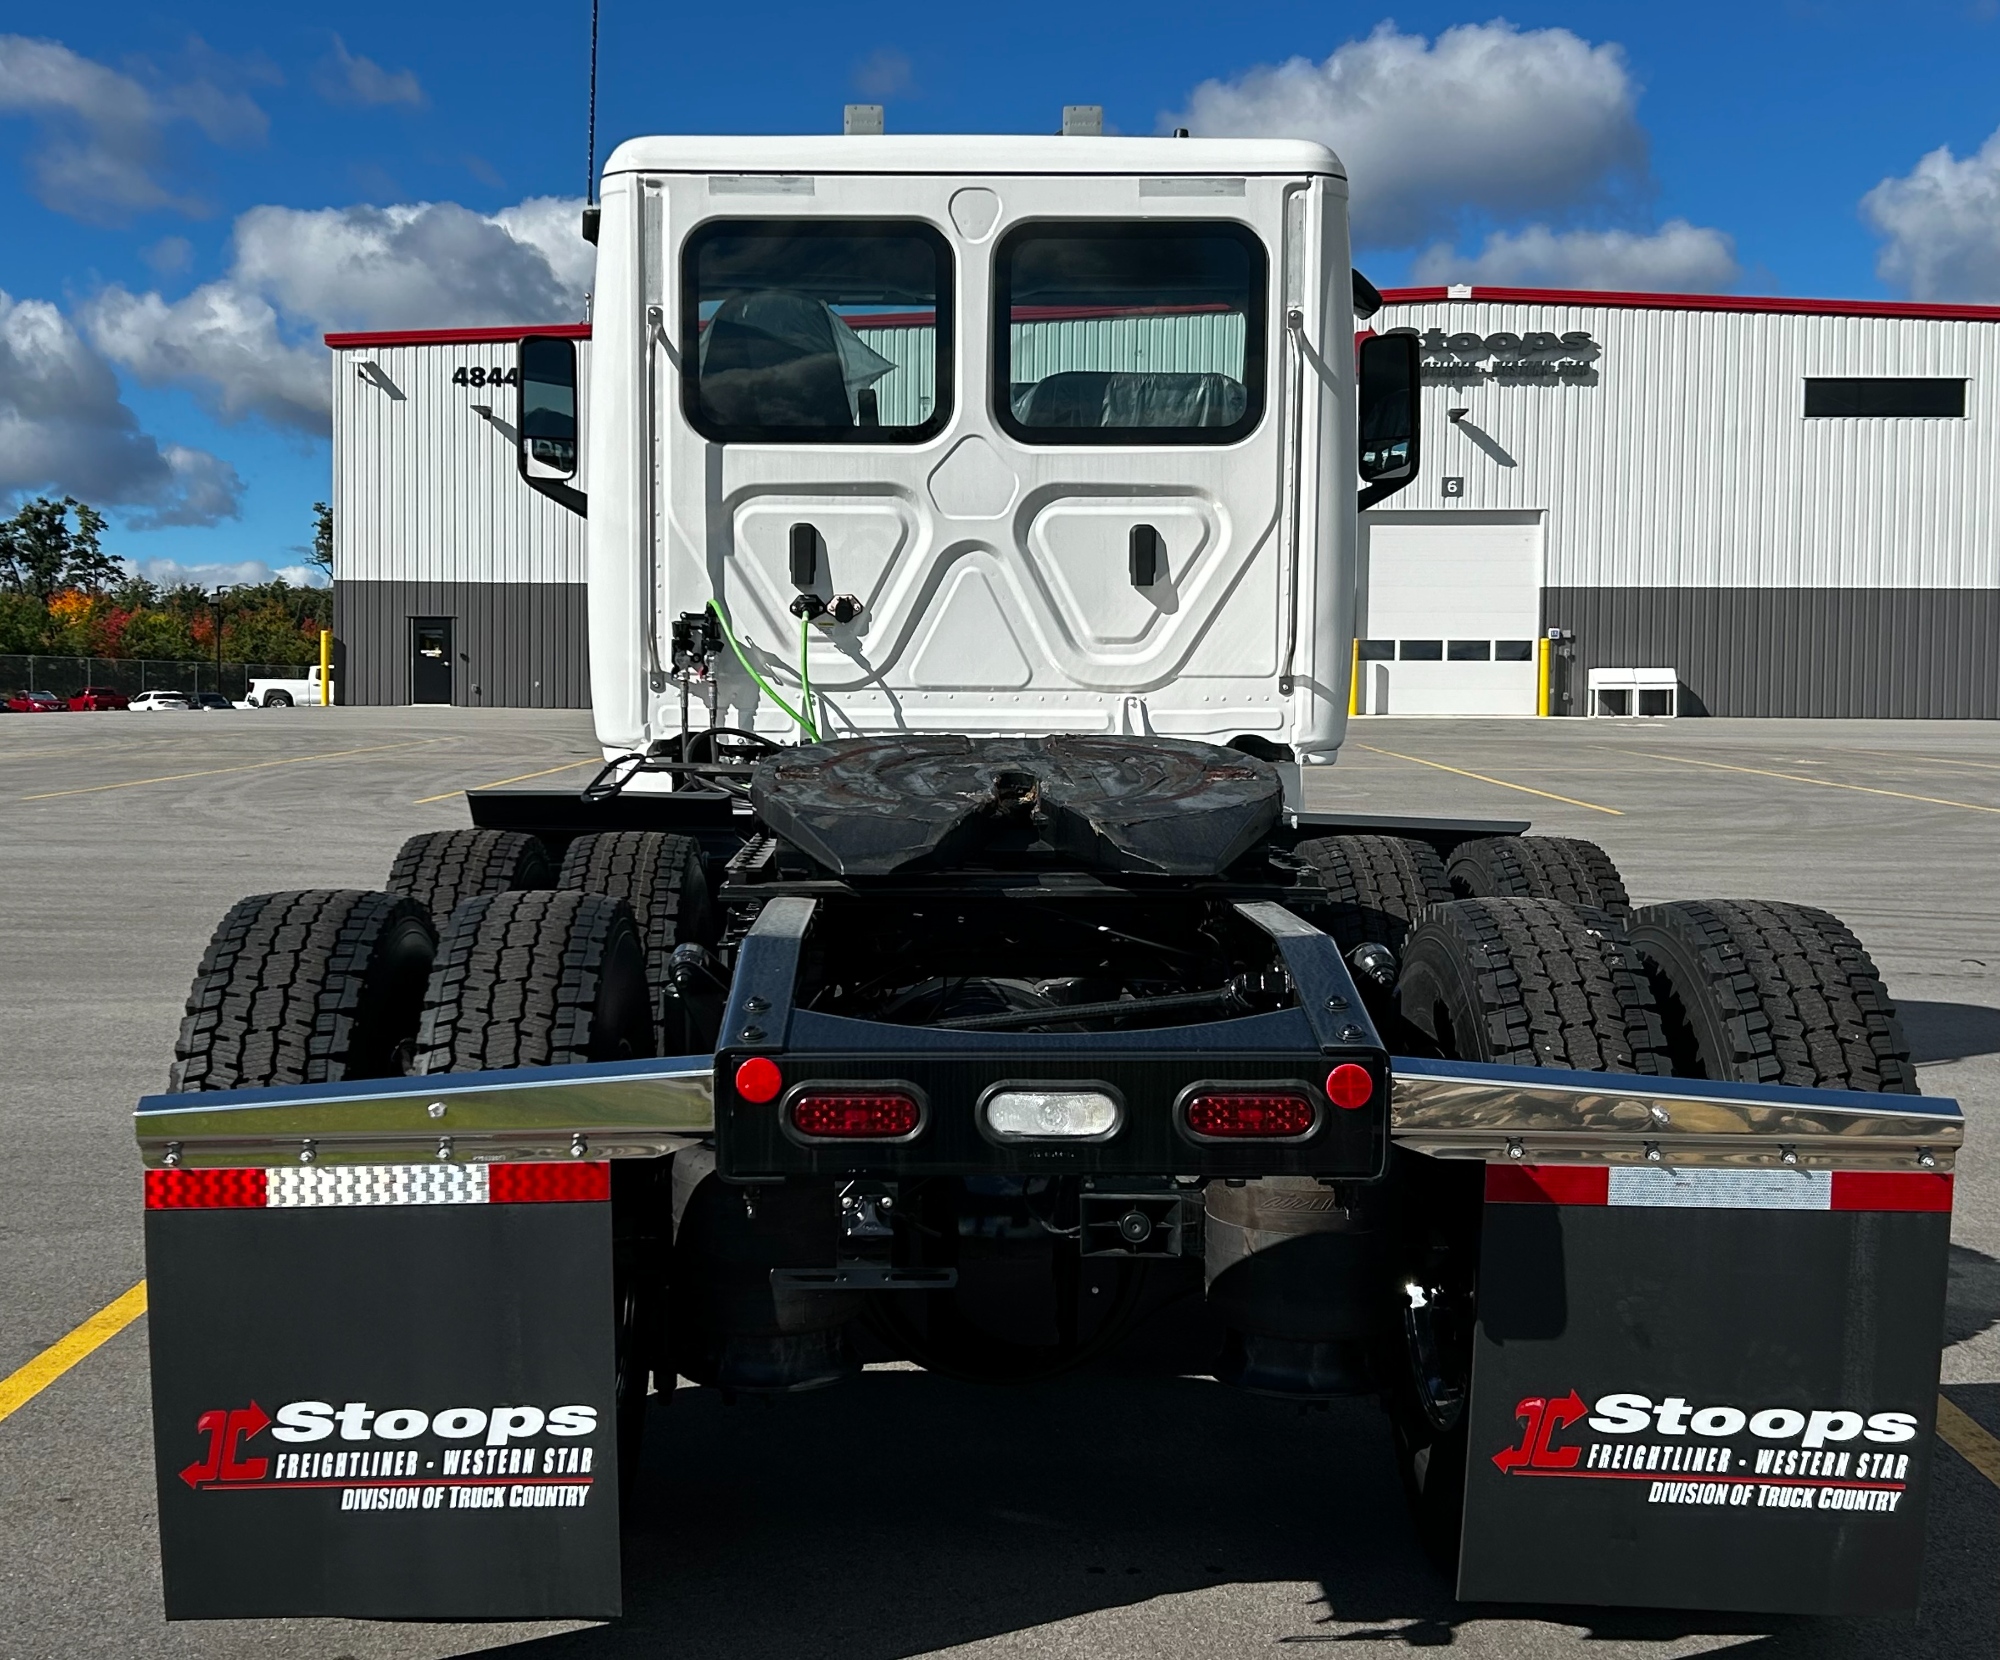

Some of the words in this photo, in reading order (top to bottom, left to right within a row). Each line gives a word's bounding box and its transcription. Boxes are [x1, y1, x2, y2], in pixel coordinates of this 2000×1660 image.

[1447, 480, 1458, 494] 6
[272, 1402, 597, 1446] Stoops
[1589, 1394, 1917, 1448] Stoops
[275, 1451, 418, 1478] FREIGHTLINER
[443, 1448, 535, 1475] WESTERN
[543, 1448, 593, 1474] STAR
[1587, 1444, 1731, 1472] FREIGHTLINER
[1755, 1449, 1850, 1476] WESTERN
[1855, 1452, 1909, 1480] STAR
[341, 1488, 420, 1510] DIVISION
[422, 1487, 445, 1509] OF
[449, 1486, 506, 1508] TRUCK
[509, 1485, 590, 1507] COUNTRY
[1648, 1482, 1728, 1505] DIVISION
[1730, 1484, 1754, 1505] OF
[1757, 1485, 1816, 1508] TRUCK
[1818, 1488, 1901, 1512] COUNTRY
